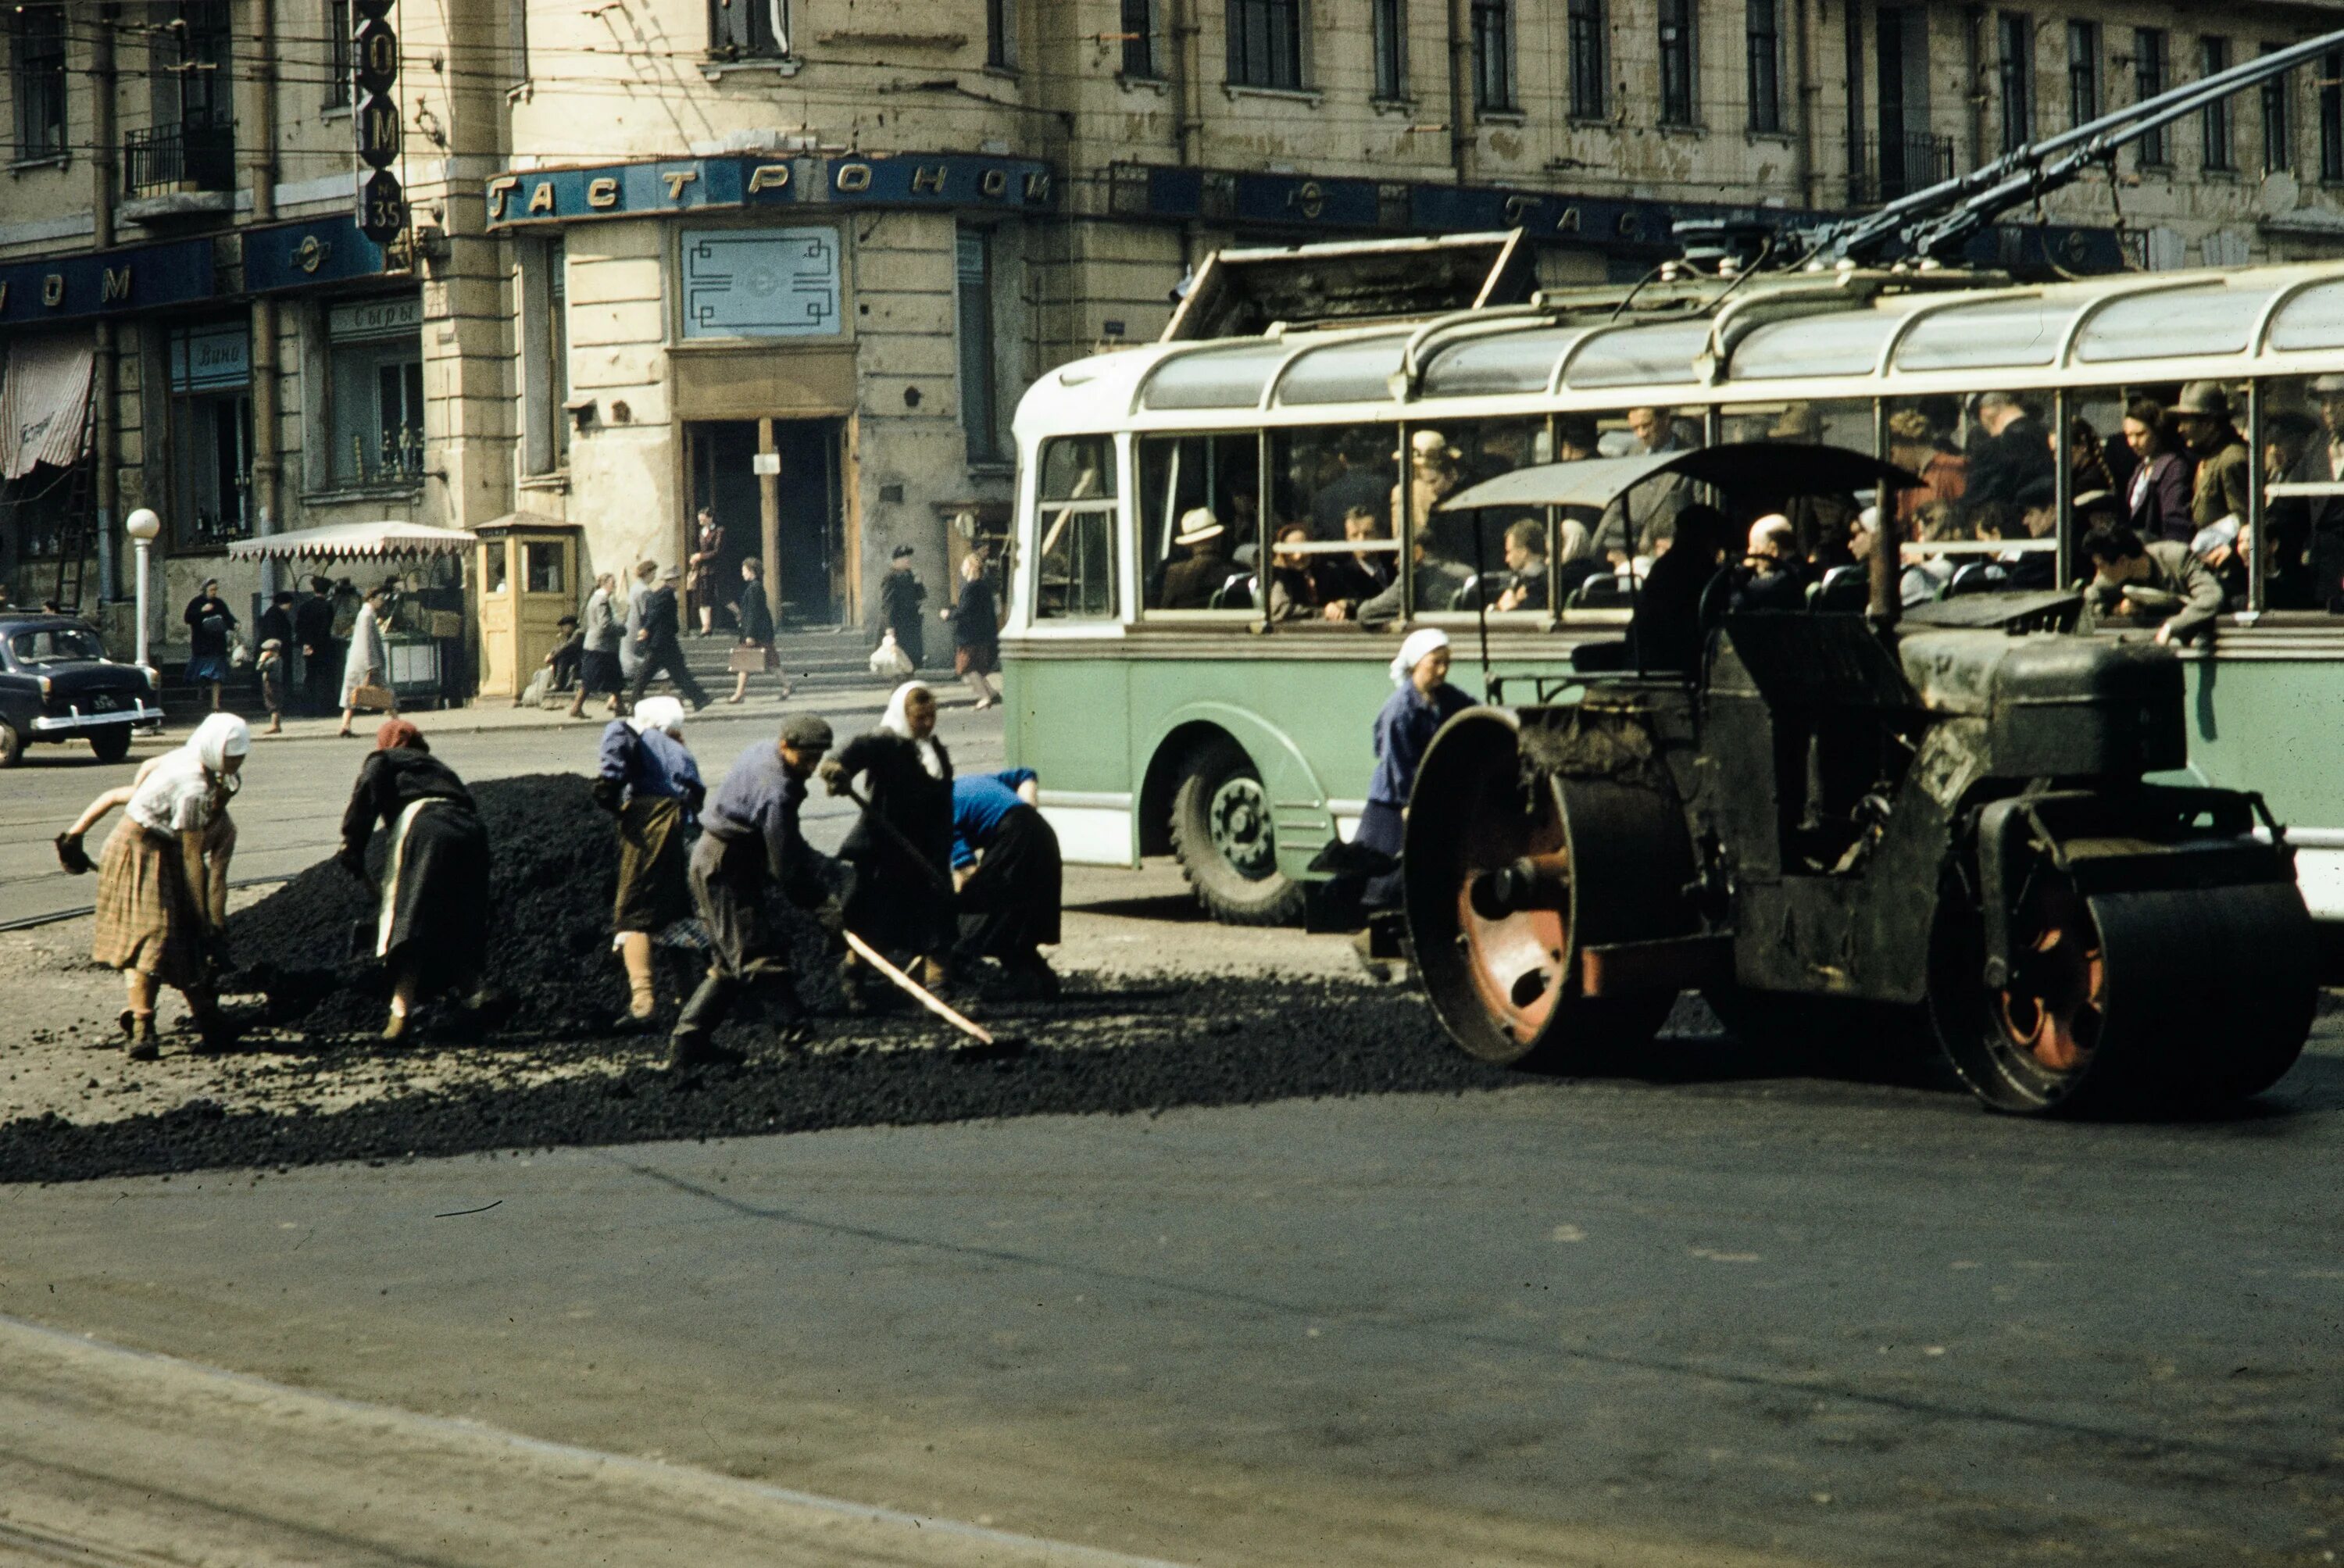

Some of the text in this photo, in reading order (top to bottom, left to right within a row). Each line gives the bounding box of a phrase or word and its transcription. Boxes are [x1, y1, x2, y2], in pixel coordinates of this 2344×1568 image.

[488, 163, 1052, 220] ГАСТРОНОМ
[372, 200, 401, 228] 35
[354, 304, 414, 330] Сыры
